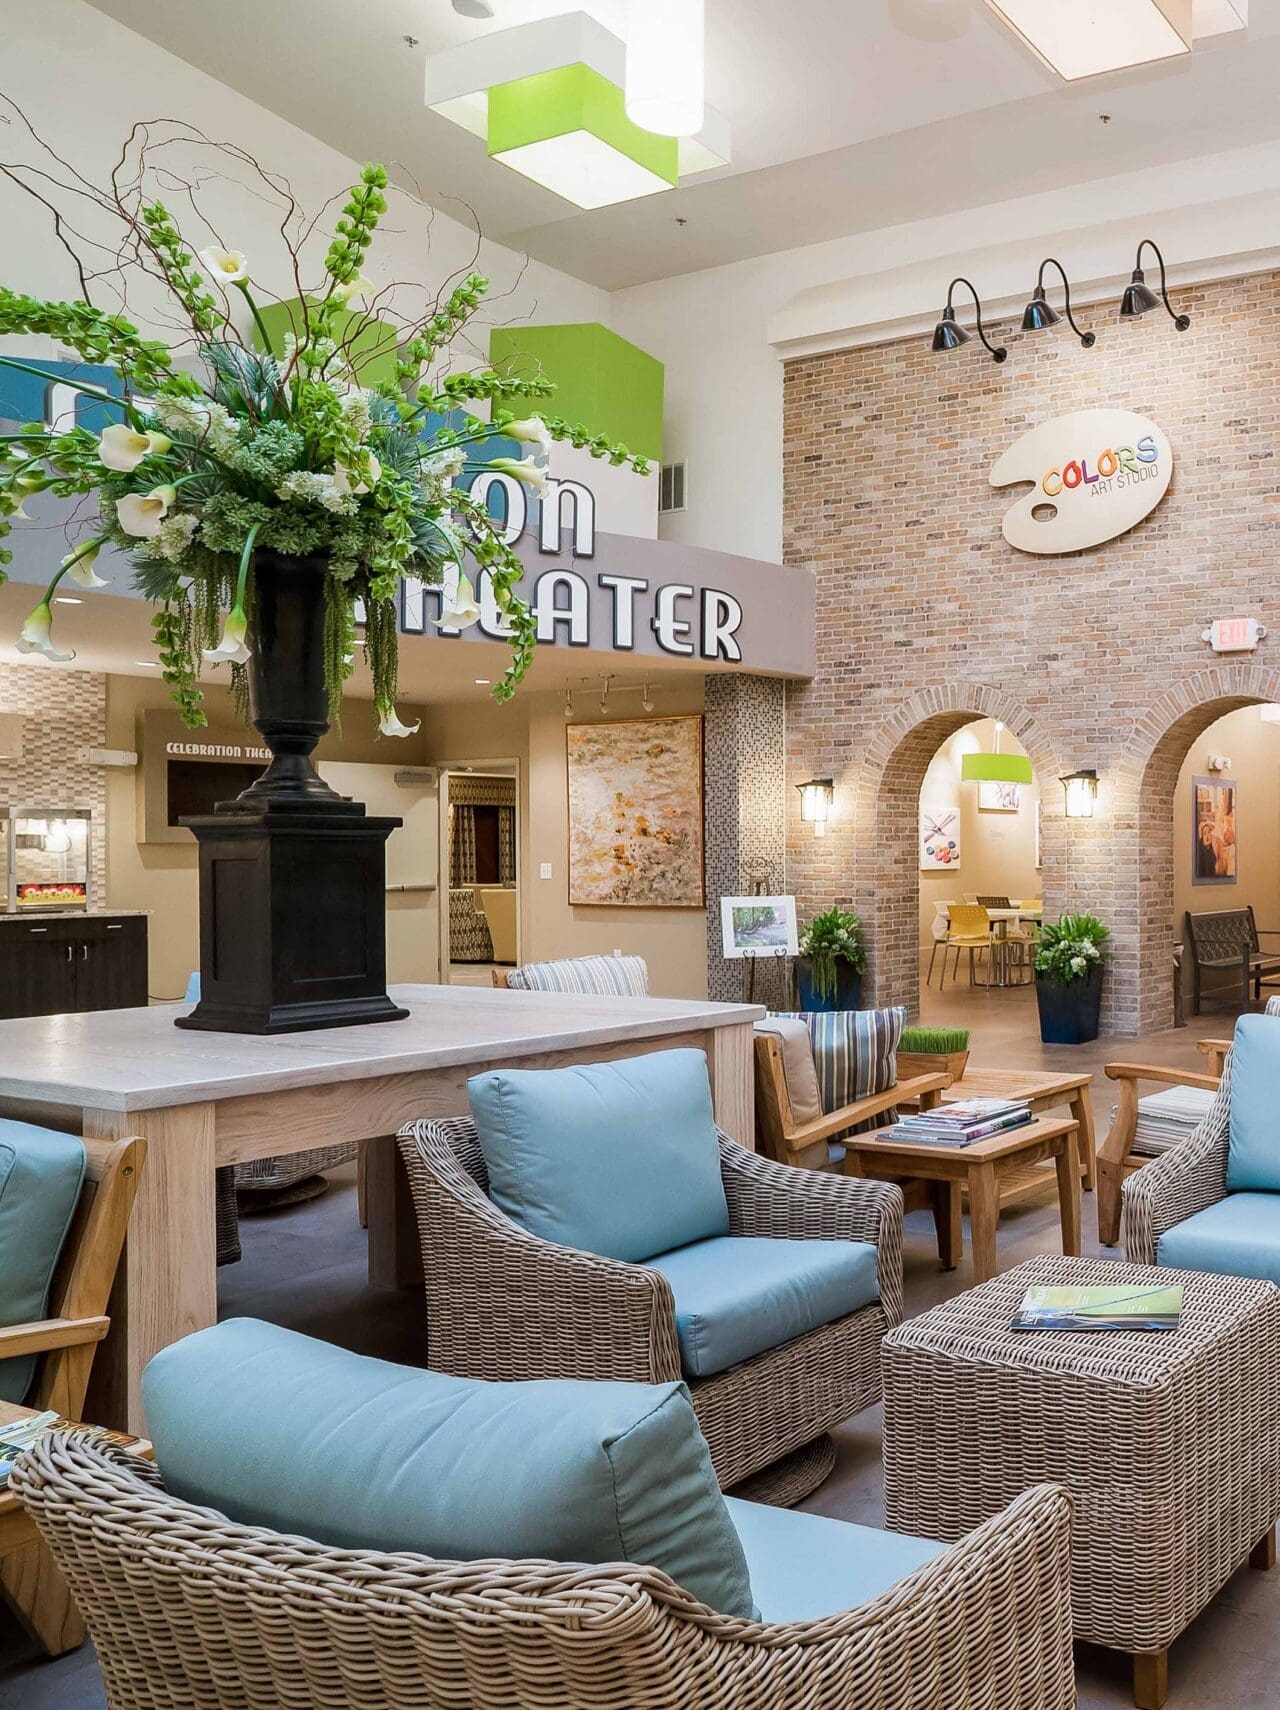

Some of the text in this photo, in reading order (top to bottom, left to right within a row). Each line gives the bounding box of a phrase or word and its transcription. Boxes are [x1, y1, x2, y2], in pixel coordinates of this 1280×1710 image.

[1041, 435, 1160, 497] COLORS
[1090, 464, 1159, 497] ART STUDIO
[353, 556, 743, 662] HEATER
[166, 742, 273, 759] CELEBRATION THEA
